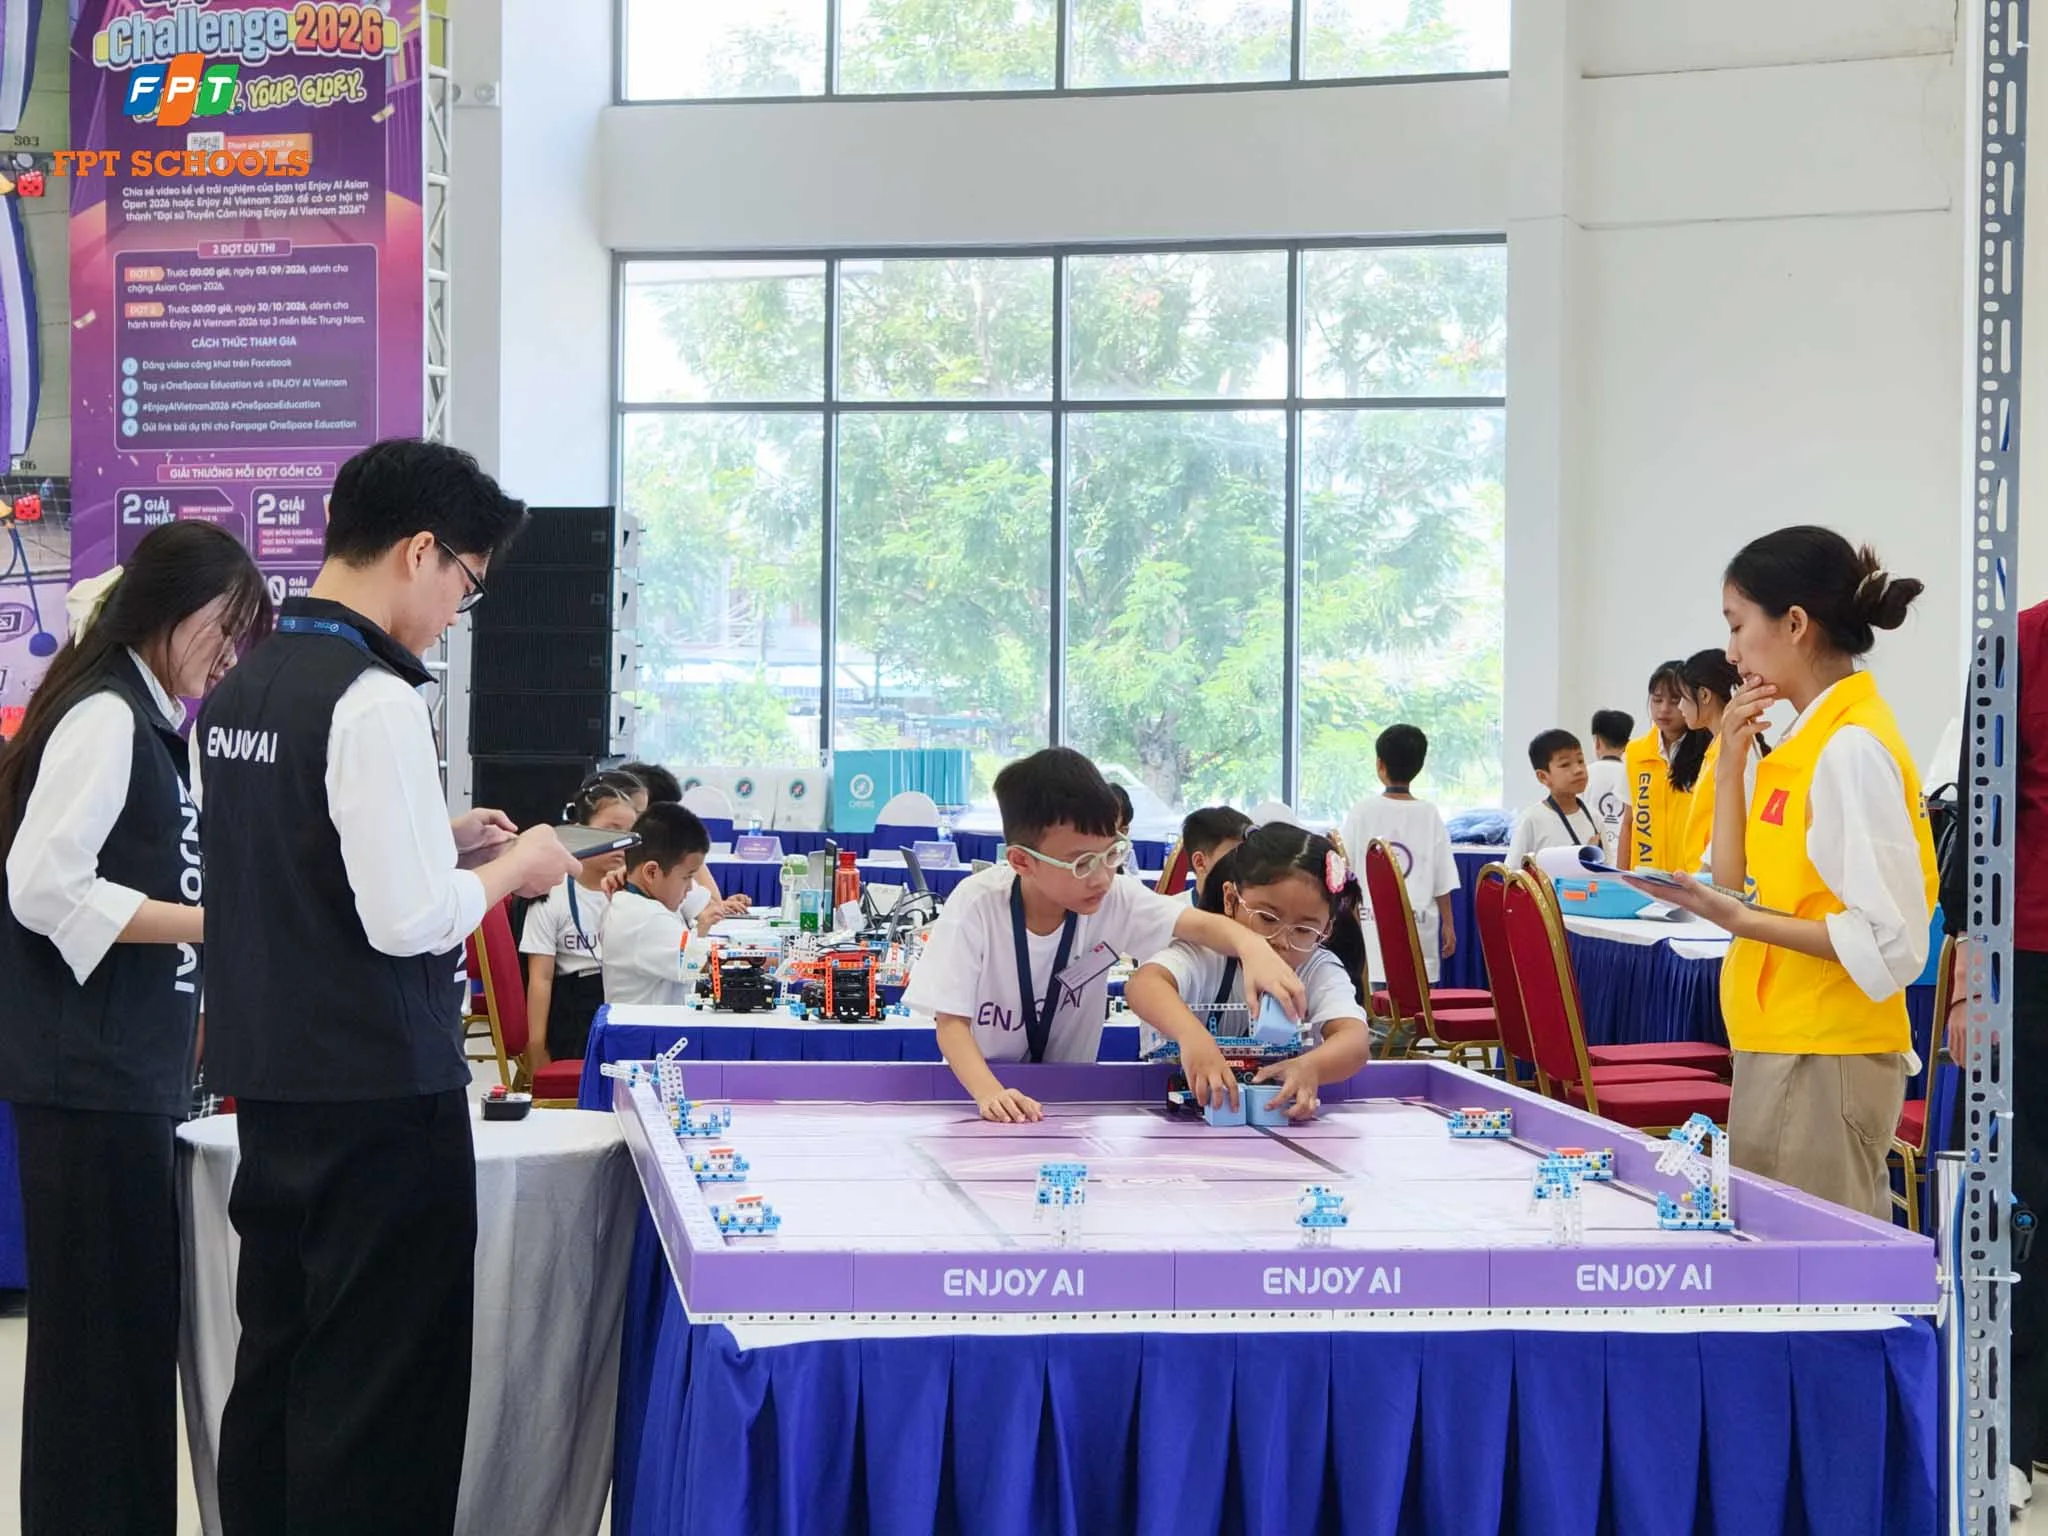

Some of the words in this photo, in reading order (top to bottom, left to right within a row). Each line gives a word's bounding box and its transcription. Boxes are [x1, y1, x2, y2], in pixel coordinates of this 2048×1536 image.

[108, 7, 289, 64] Challenge
[295, 3, 384, 55] 2026
[249, 76, 298, 109] YOUR
[300, 69, 366, 105] GLORY.
[156, 185, 180, 196] video
[308, 180, 331, 193] Enjoy
[333, 180, 342, 189] AI
[344, 179, 368, 189] Asian
[122, 198, 147, 210] Open
[149, 198, 169, 208] 2026
[197, 196, 220, 208] Enjoy
[222, 196, 231, 206] AI
[234, 195, 270, 206] Vietnam
[273, 194, 295, 205] 2026
[264, 207, 287, 218] Enjoy
[289, 206, 298, 216] AI
[300, 205, 337, 216] Vietnam
[259, 242, 276, 253] THI
[190, 267, 215, 277] 00:00
[332, 263, 349, 273] cho
[154, 283, 177, 292] Asian
[178, 282, 202, 293] Open
[191, 304, 216, 313] 00:00
[333, 301, 349, 310] cho
[169, 318, 191, 330] Enjoy
[193, 318, 201, 328] AI
[202, 318, 237, 327] Vietnam
[238, 317, 258, 327] 2026
[318, 315, 342, 327] Trung
[250, 335, 277, 347] THAM
[279, 335, 297, 346] GIA
[166, 360, 190, 369] video
[250, 358, 292, 367] Facebook
[142, 381, 158, 392] Tag
[210, 379, 252, 389] Education
[302, 378, 312, 387] AI
[312, 377, 348, 387] Vietnam
[213, 421, 229, 430] cho
[230, 419, 268, 432] Fanpage
[269, 419, 313, 431] OneSpace
[314, 418, 357, 429] Education
[123, 493, 142, 525] 2
[257, 493, 276, 525] 2
[279, 495, 305, 511] GIẢI
[1635, 772, 1652, 838] ENJOY
[1637, 841, 1653, 862] AI
[564, 933, 601, 950] ENJ
[943, 1268, 1048, 1296] ENJOY
[1051, 1268, 1084, 1296] AI
[1263, 1266, 1365, 1295] ENJOY
[1368, 1266, 1400, 1294] AI
[1576, 1263, 1676, 1291] ENJOY
[1680, 1263, 1712, 1290] AI
